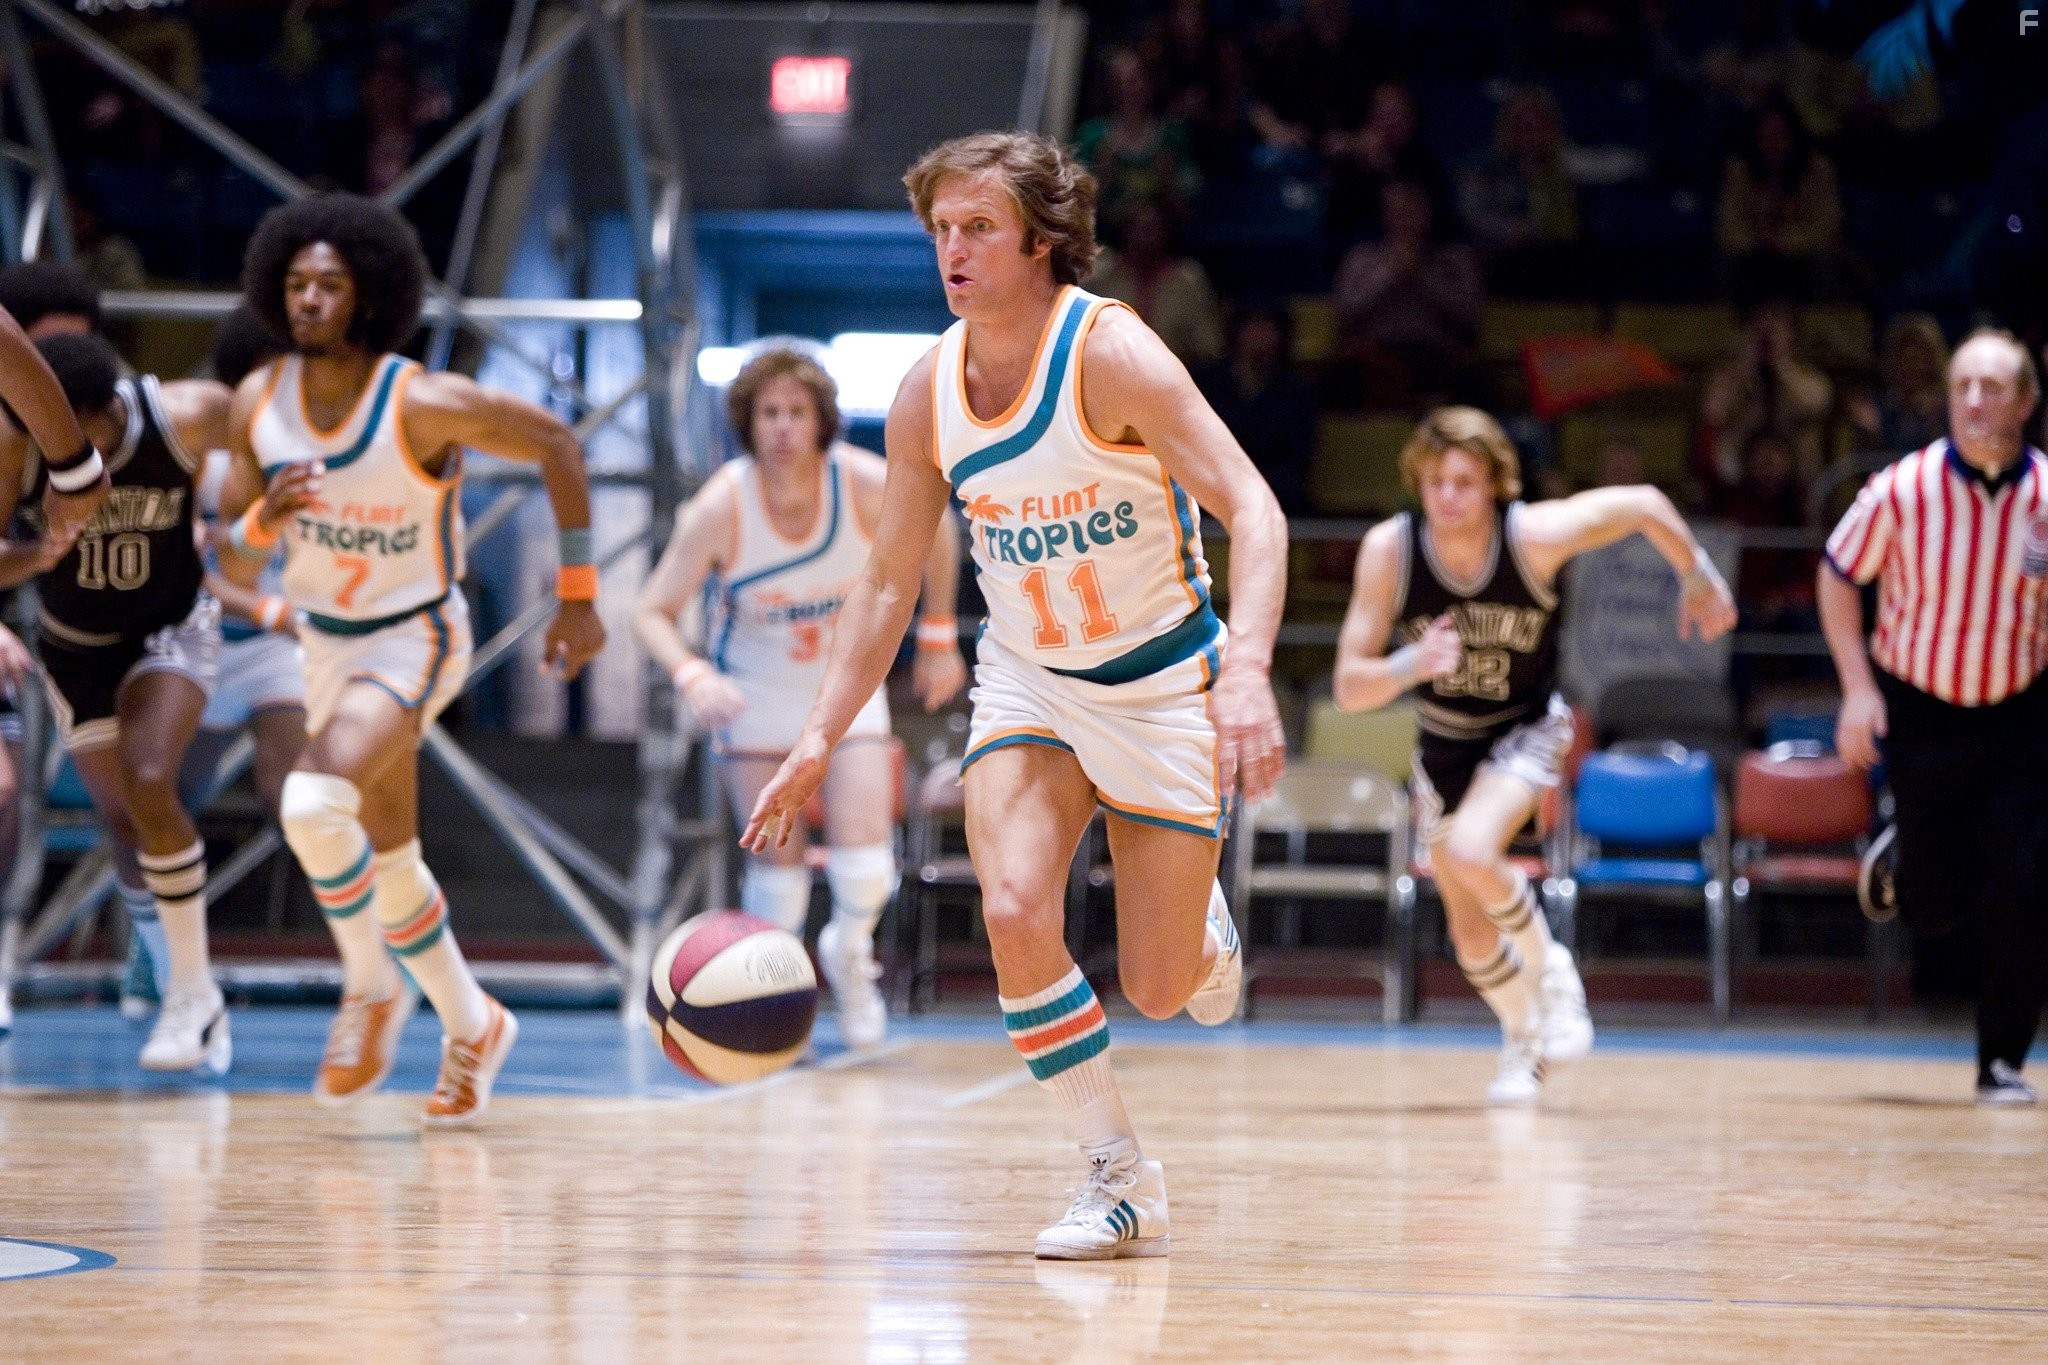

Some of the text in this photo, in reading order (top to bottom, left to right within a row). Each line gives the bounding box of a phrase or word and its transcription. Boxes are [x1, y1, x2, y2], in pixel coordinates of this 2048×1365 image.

[1021, 482, 1101, 522] FLINT
[297, 514, 420, 556] TROPICS
[985, 500, 1138, 566] TROPICS
[77, 533, 150, 591] 10
[334, 553, 371, 609] 7
[1020, 559, 1120, 650] 11
